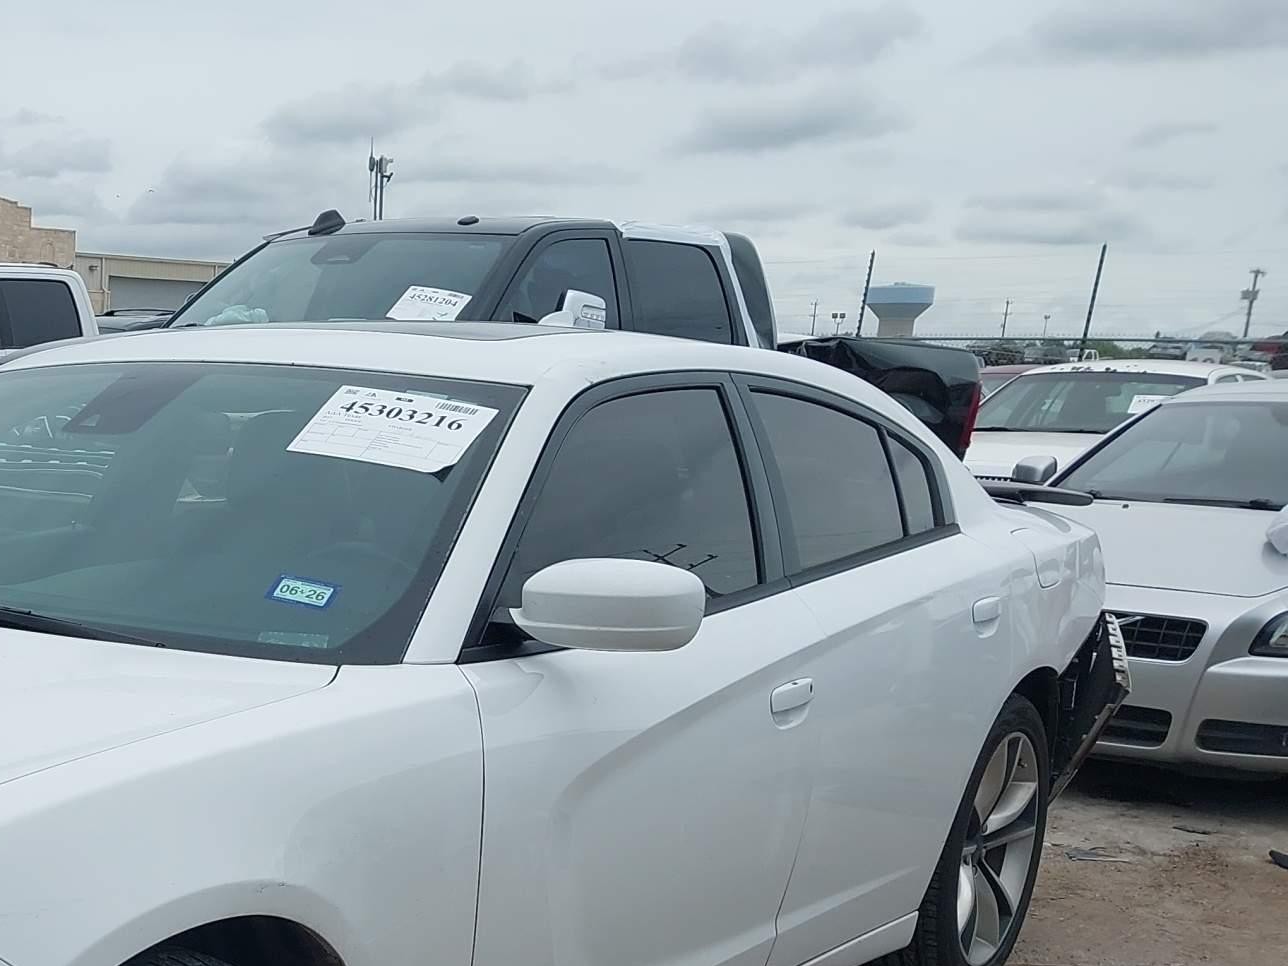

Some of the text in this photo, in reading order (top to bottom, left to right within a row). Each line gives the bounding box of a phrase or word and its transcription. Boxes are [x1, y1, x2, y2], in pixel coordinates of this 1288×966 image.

[340, 400, 468, 431] 45303216
[279, 584, 327, 601] 06 26
